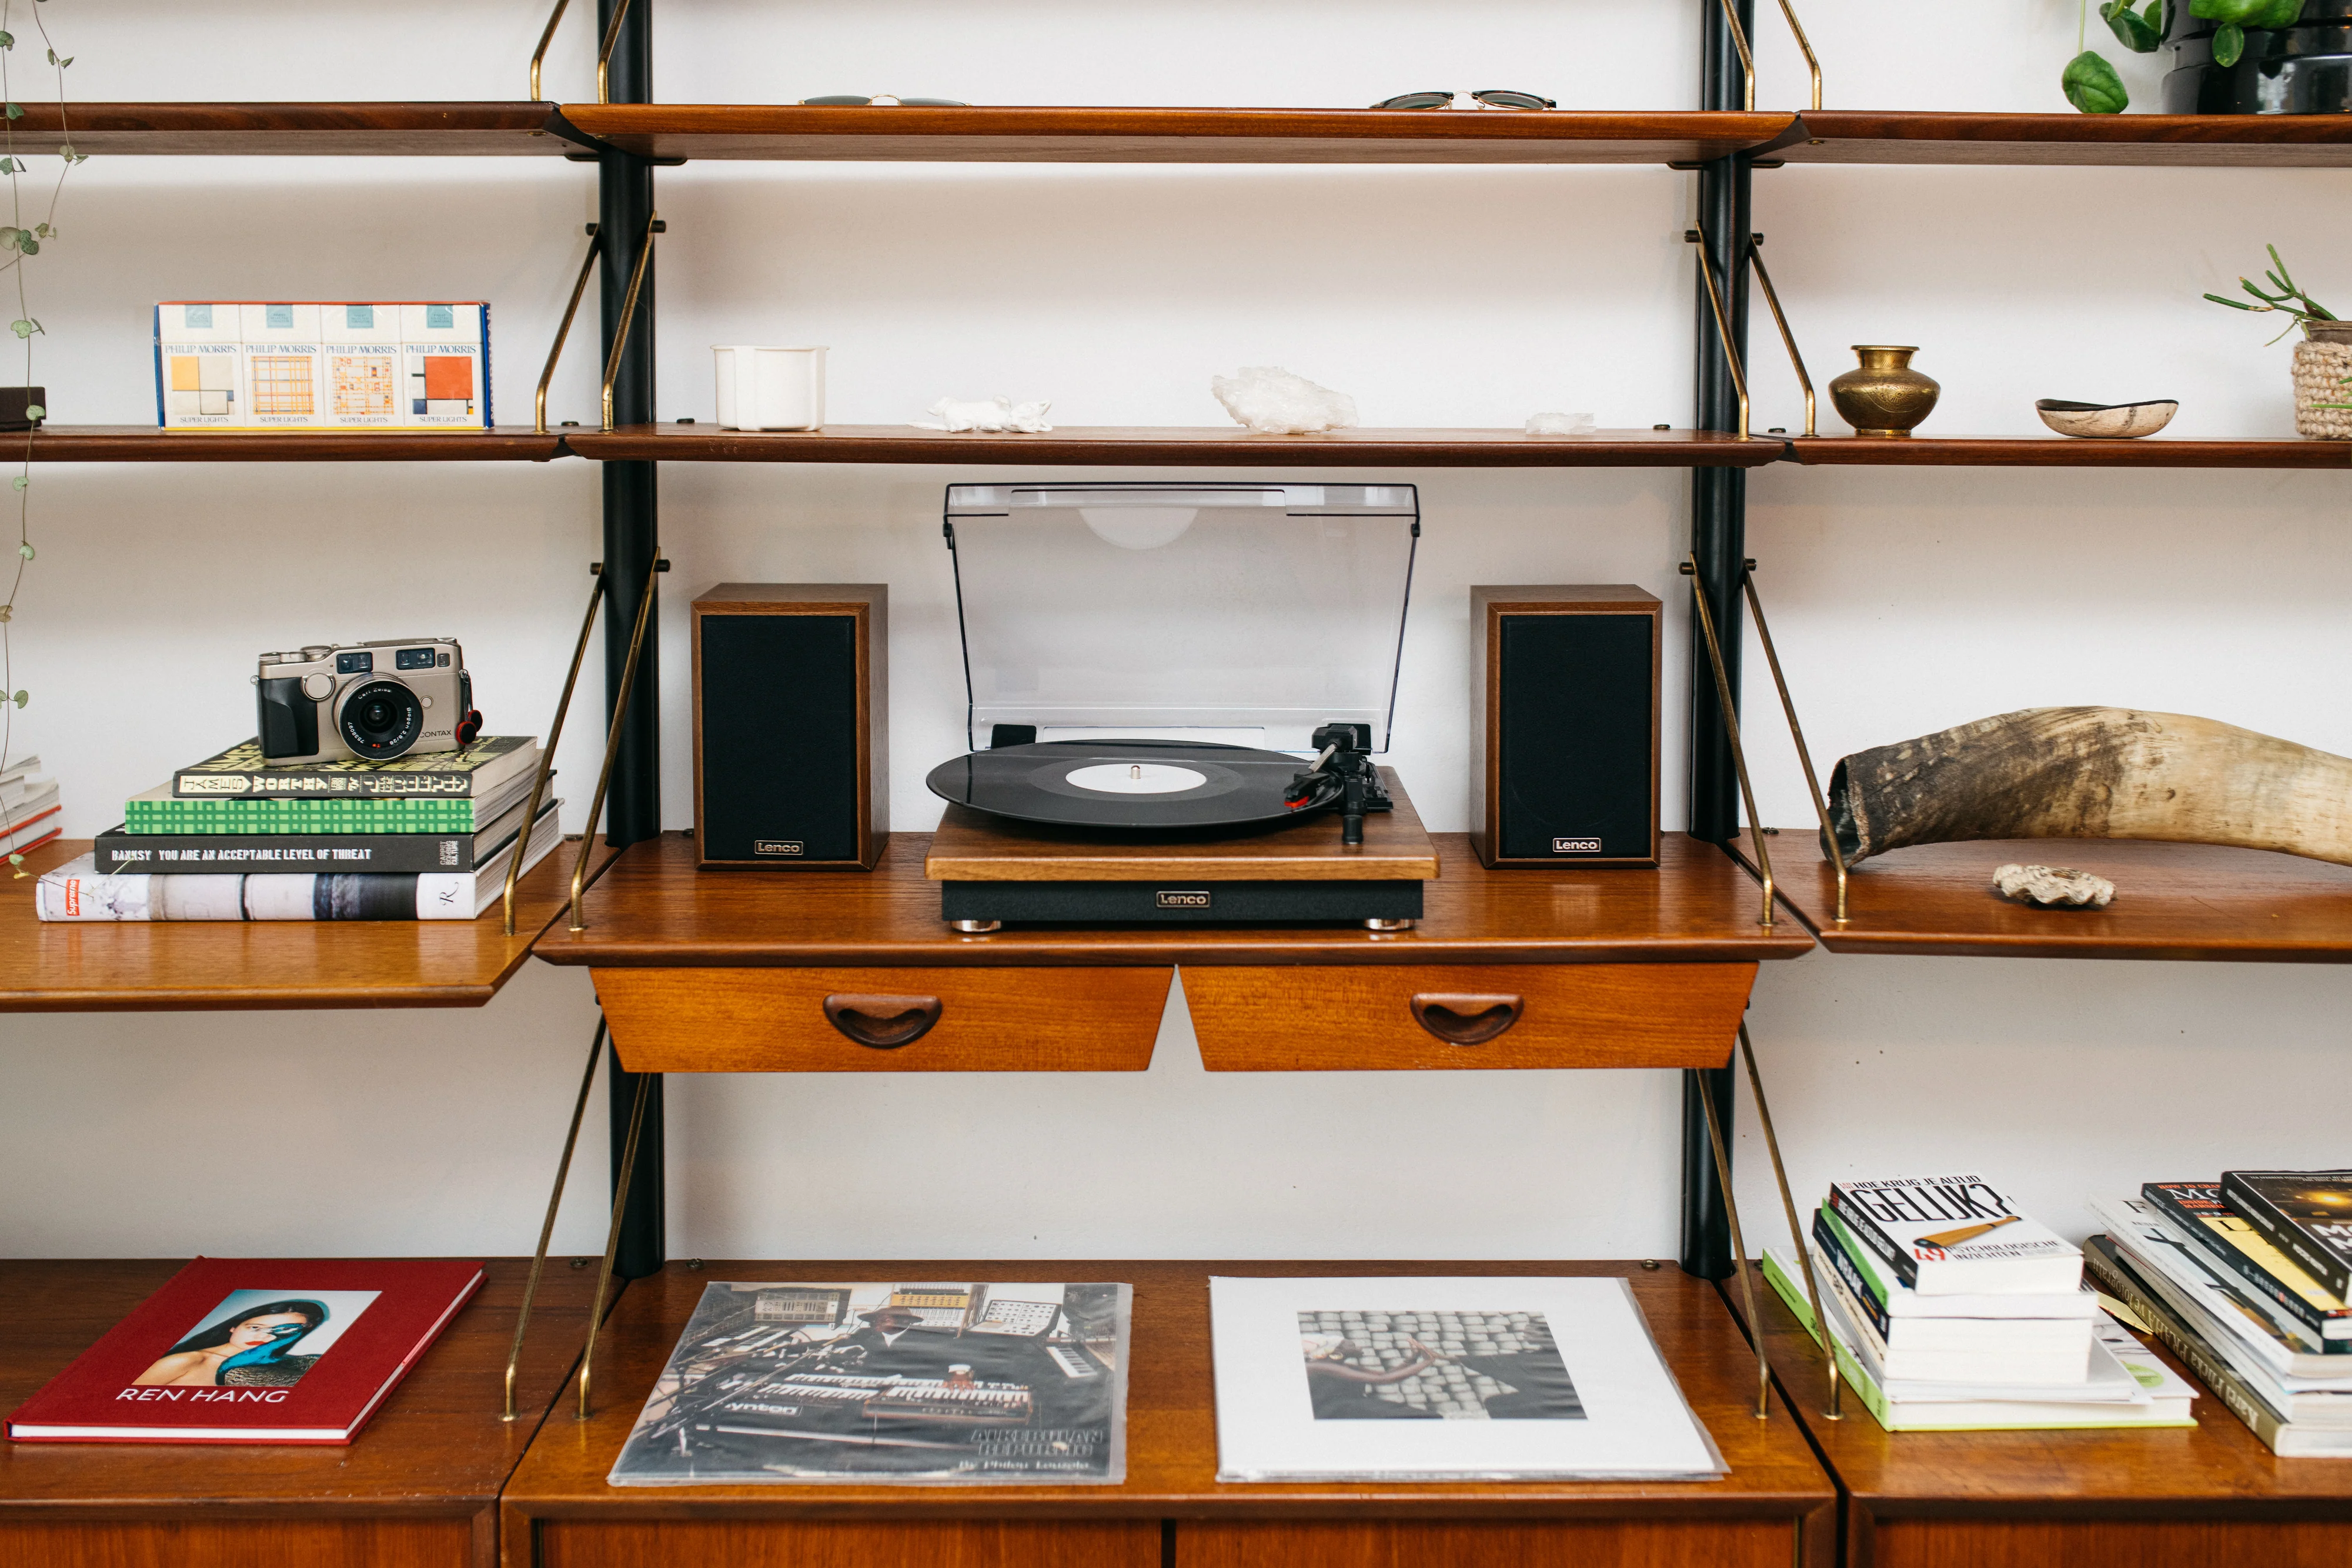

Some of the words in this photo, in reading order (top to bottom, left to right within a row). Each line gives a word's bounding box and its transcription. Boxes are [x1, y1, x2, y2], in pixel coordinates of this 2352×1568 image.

[165, 345, 196, 353] PHILIP
[198, 345, 236, 353] MORRIS
[246, 345, 276, 353] PHILIP
[358, 690, 371, 700] Carl
[348, 722, 365, 744] 7538097
[420, 730, 452, 738] CONTAX
[184, 777, 244, 790] JAMES
[253, 775, 328, 793] WORTHY
[758, 842, 800, 852] Lenco
[1556, 840, 1598, 850] Lenco
[111, 850, 152, 861] BANKSY
[158, 850, 179, 860] YOU
[180, 850, 201, 860] ARE
[202, 850, 216, 860] AN
[217, 849, 282, 860] ACCEPTABLE
[283, 849, 316, 860] LEVEL
[316, 849, 330, 860] OF
[332, 849, 372, 860] THREAT
[67, 880, 78, 915] Supreme
[1160, 894, 1207, 904] Lenco
[1883, 1179, 1921, 1187] KRIJG
[1940, 1175, 1982, 1184] ALTIJD
[1849, 1183, 2013, 1222] GELIJK?
[1945, 1241, 2061, 1253] PSYCHOLOGISCHE
[1914, 1248, 1946, 1262] 49
[1953, 1251, 2023, 1260] INZICHTEN
[2133, 1298, 2147, 1316] ve
[2147, 1309, 2189, 1362] PRAHA
[2190, 1355, 2224, 1397] Plicka
[115, 1388, 186, 1401] REN
[190, 1389, 289, 1403] HANG
[2224, 1386, 2260, 1432] Karel
